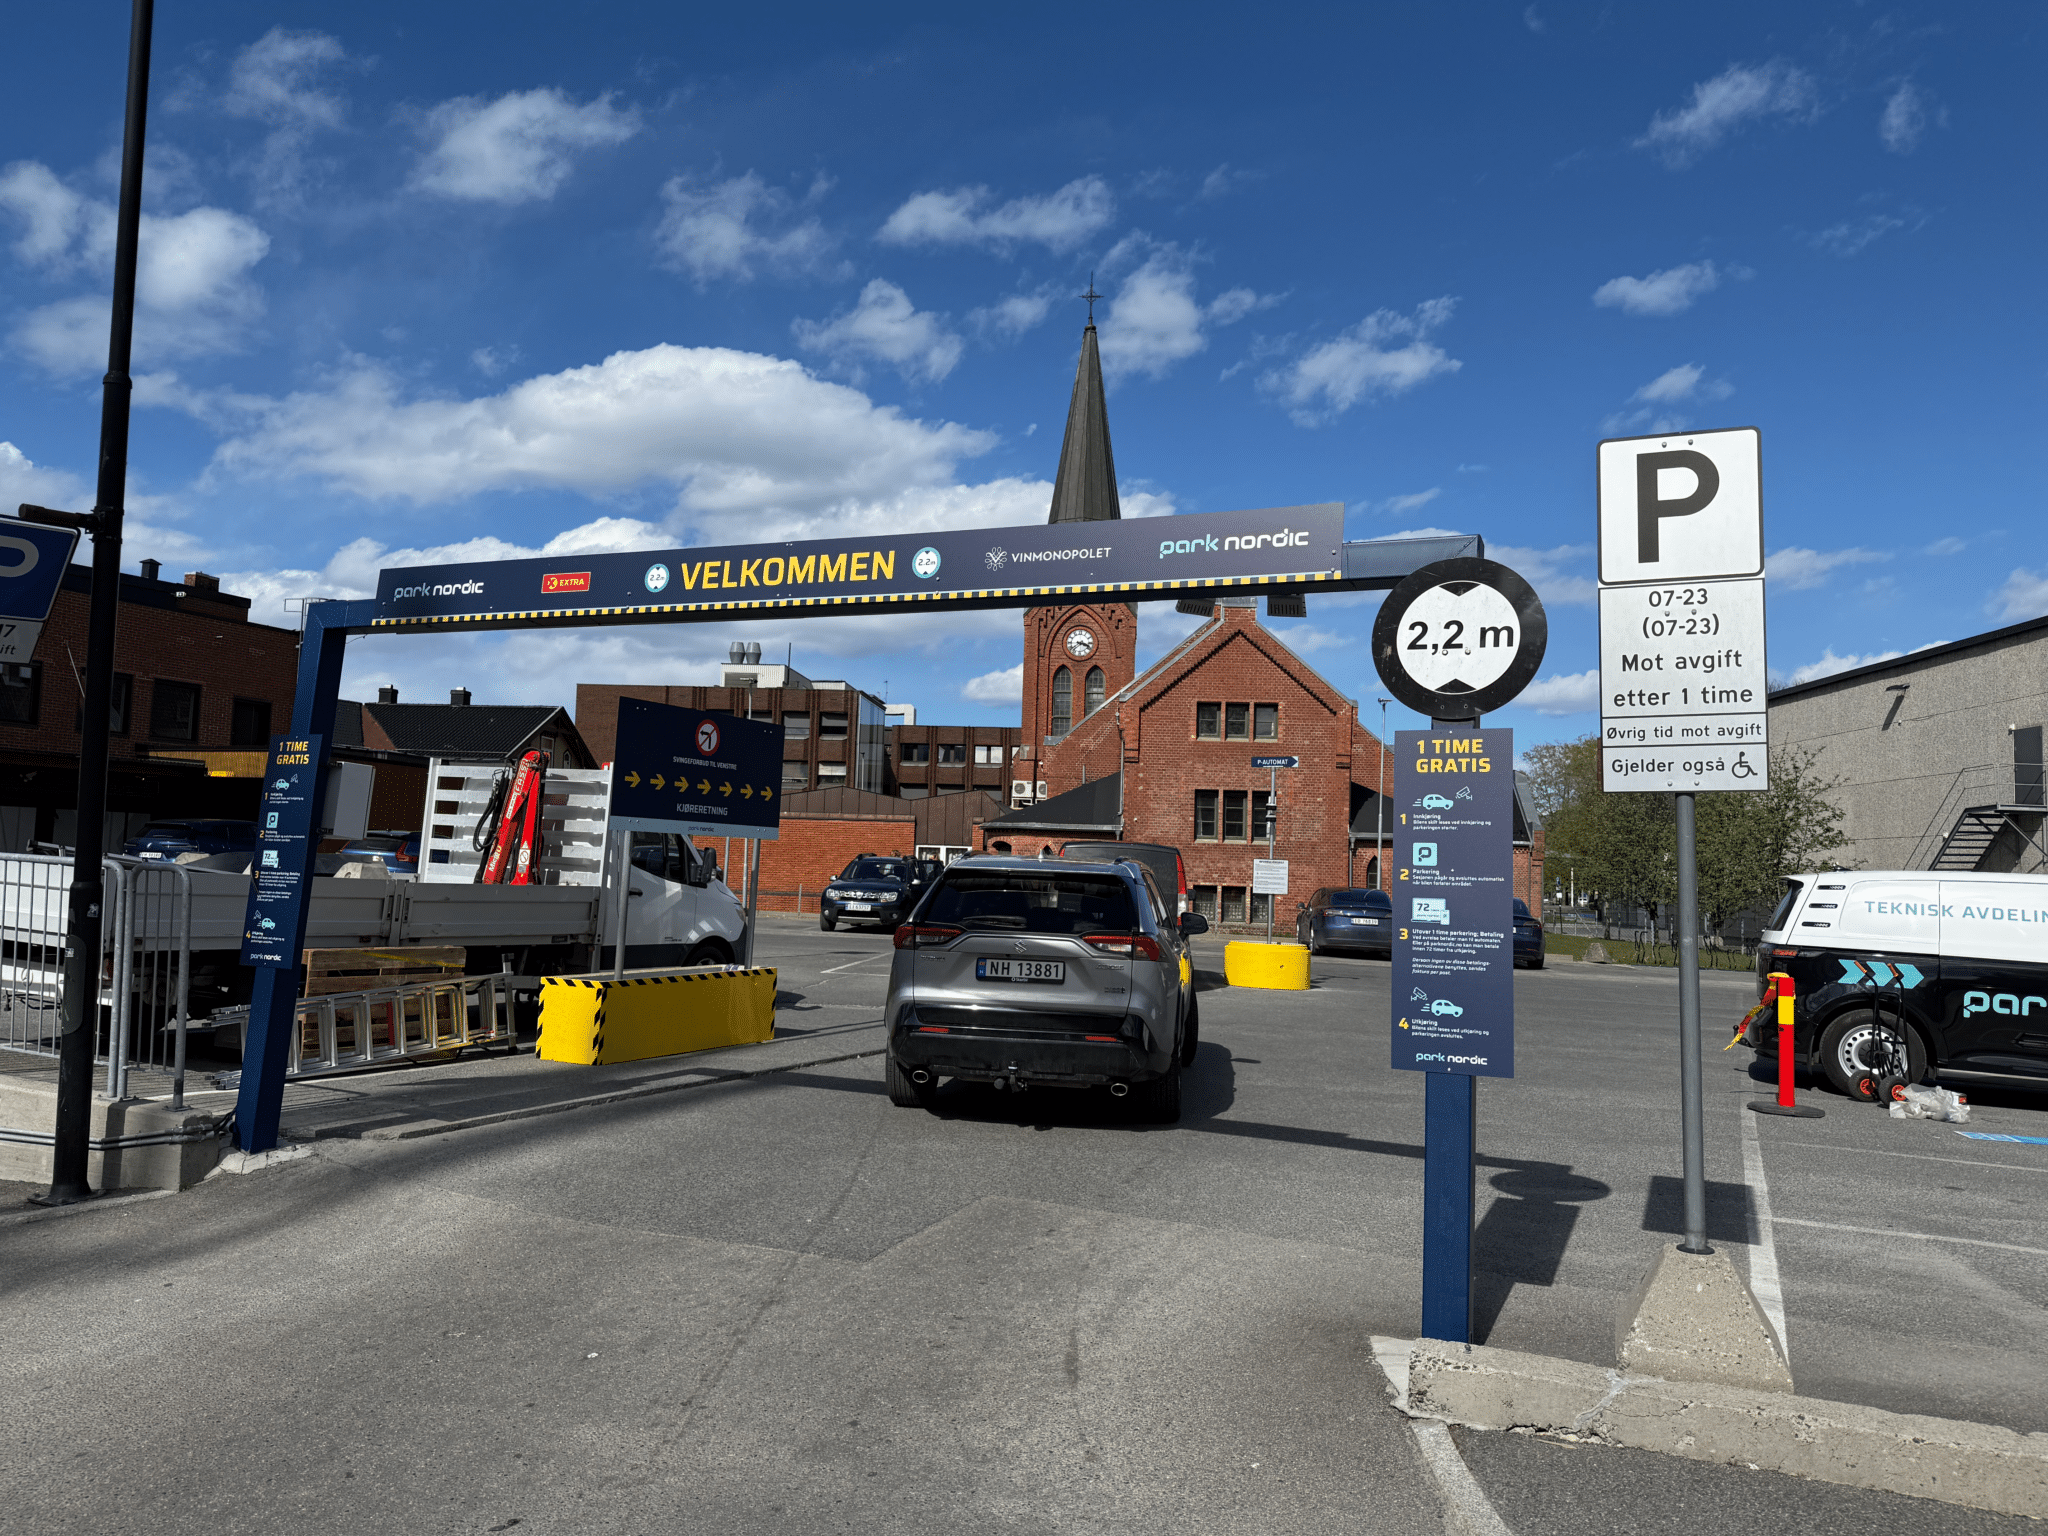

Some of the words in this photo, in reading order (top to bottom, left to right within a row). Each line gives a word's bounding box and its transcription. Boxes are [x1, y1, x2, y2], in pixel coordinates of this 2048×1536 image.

[1636, 450, 1720, 563] P
[1160, 534, 1218, 558] park
[1225, 528, 1309, 550] nordic
[1012, 548, 1111, 563] VINMONOPOLET
[681, 550, 895, 590] VELKOMMEN
[559, 578, 584, 587] EXTRA
[394, 583, 430, 601] park
[433, 580, 484, 596] nordic
[1649, 588, 1708, 608] 07-23
[1643, 614, 1720, 638] (07-23)
[1407, 620, 1464, 655] 2,2
[1480, 626, 1514, 648] m
[1622, 654, 1664, 672] Mot
[1675, 650, 1742, 673] avgift
[1614, 689, 1670, 707] etter
[1682, 688, 1688, 704] 1
[1701, 686, 1753, 704] time
[1607, 727, 1646, 741] Øvrig
[1654, 726, 1672, 738] tid
[1682, 725, 1710, 737] mot
[1718, 723, 1762, 738] avgift
[280, 742, 284, 752] 1
[286, 741, 309, 752] TIME
[1417, 740, 1425, 754] 1
[1432, 739, 1483, 754] TIME
[276, 754, 309, 764] GRATIS
[673, 756, 709, 767] SVINGEFORBUD
[717, 762, 737, 770] VENSTRE
[1416, 758, 1491, 773] GRATIS
[1612, 758, 1674, 776] Gjelder
[1683, 757, 1724, 775] også
[676, 802, 728, 816] KJØRERETNING
[1400, 813, 1406, 825] 1
[1400, 869, 1409, 880] 2
[1417, 903, 1429, 911] 72
[1864, 901, 1954, 917] TEKNISK
[1400, 928, 1408, 939] 3
[990, 961, 1010, 975] NH
[1018, 963, 1059, 978] 13881
[1399, 1018, 1409, 1030] 4
[1416, 1053, 1445, 1062] park
[1448, 1055, 1487, 1065] nordic
